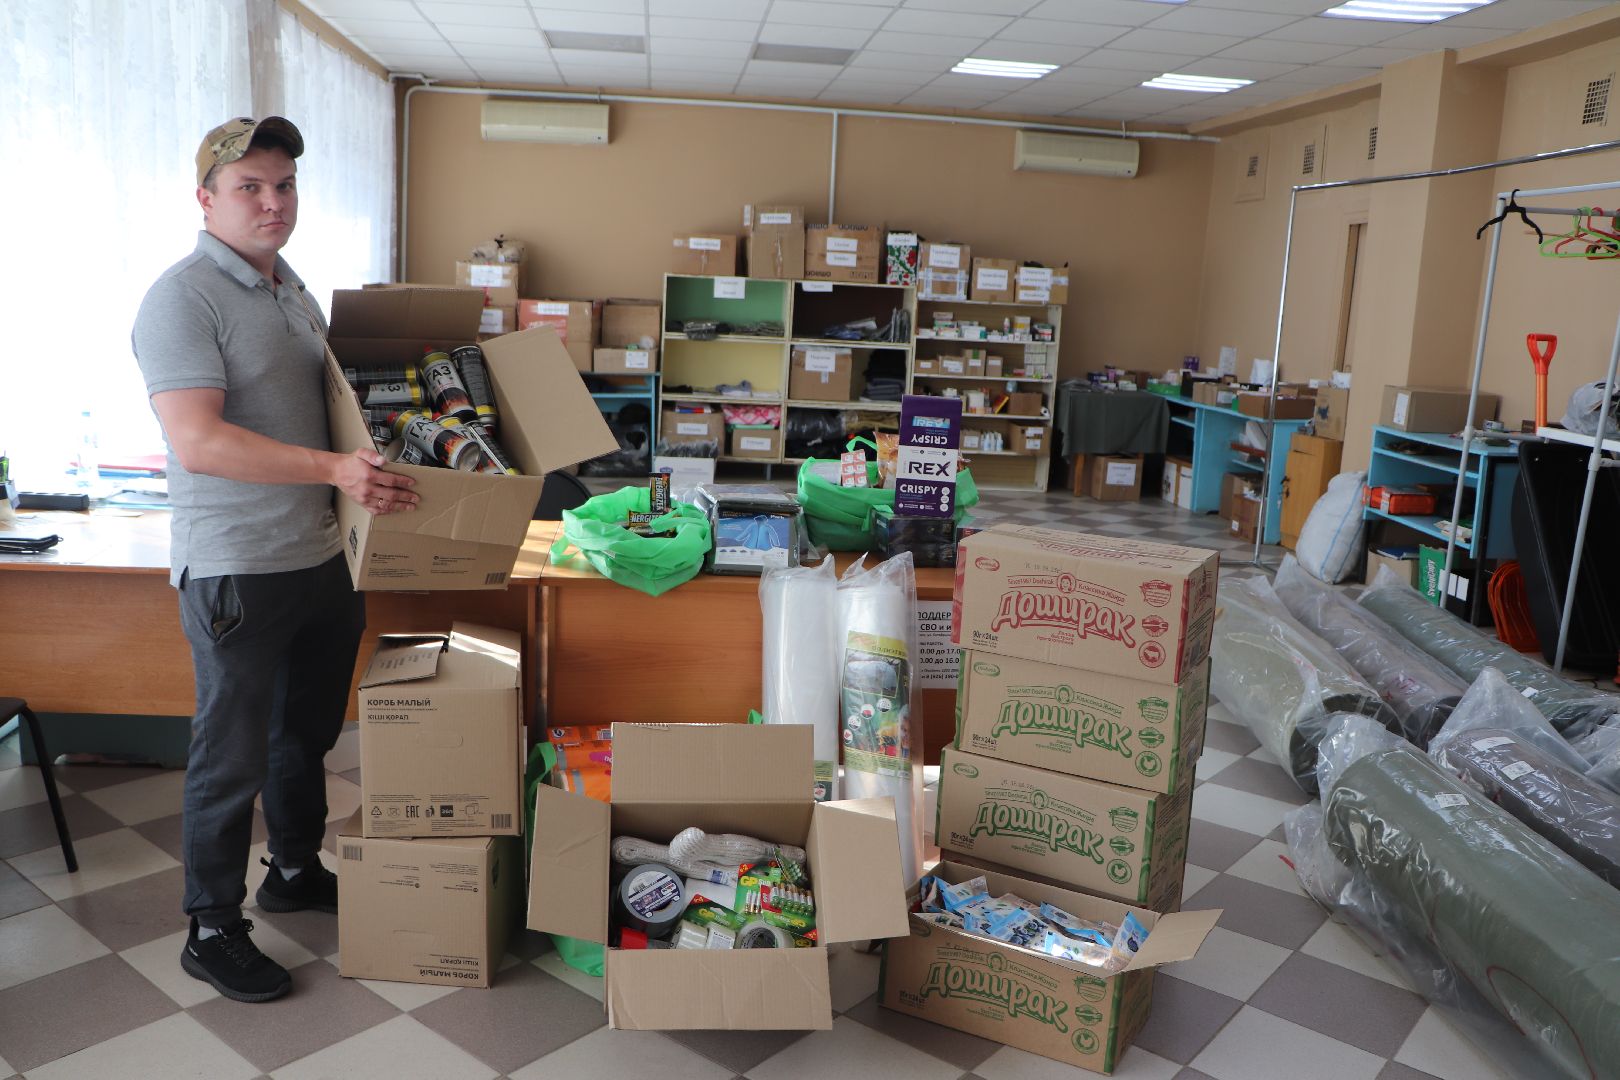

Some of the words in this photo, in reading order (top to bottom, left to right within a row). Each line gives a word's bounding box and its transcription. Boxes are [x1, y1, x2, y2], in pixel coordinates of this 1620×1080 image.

[426, 365, 452, 384] ГАЗ
[911, 433, 948, 445] CRISPY
[908, 461, 951, 477] REX
[900, 483, 938, 495] CRISPY
[1078, 583, 1105, 597] Классика
[1105, 591, 1125, 603] Жанра
[991, 591, 1136, 648] Доширак
[920, 623, 937, 631] СВО
[397, 697, 431, 706] МАЛЫЙ
[991, 700, 1133, 758] Доширак
[969, 801, 1105, 865] Доширак
[740, 875, 758, 887] GP
[419, 969, 451, 978] МАЛЫЙ
[452, 971, 479, 980] КОРОБ
[920, 961, 1069, 1034] Доширак
